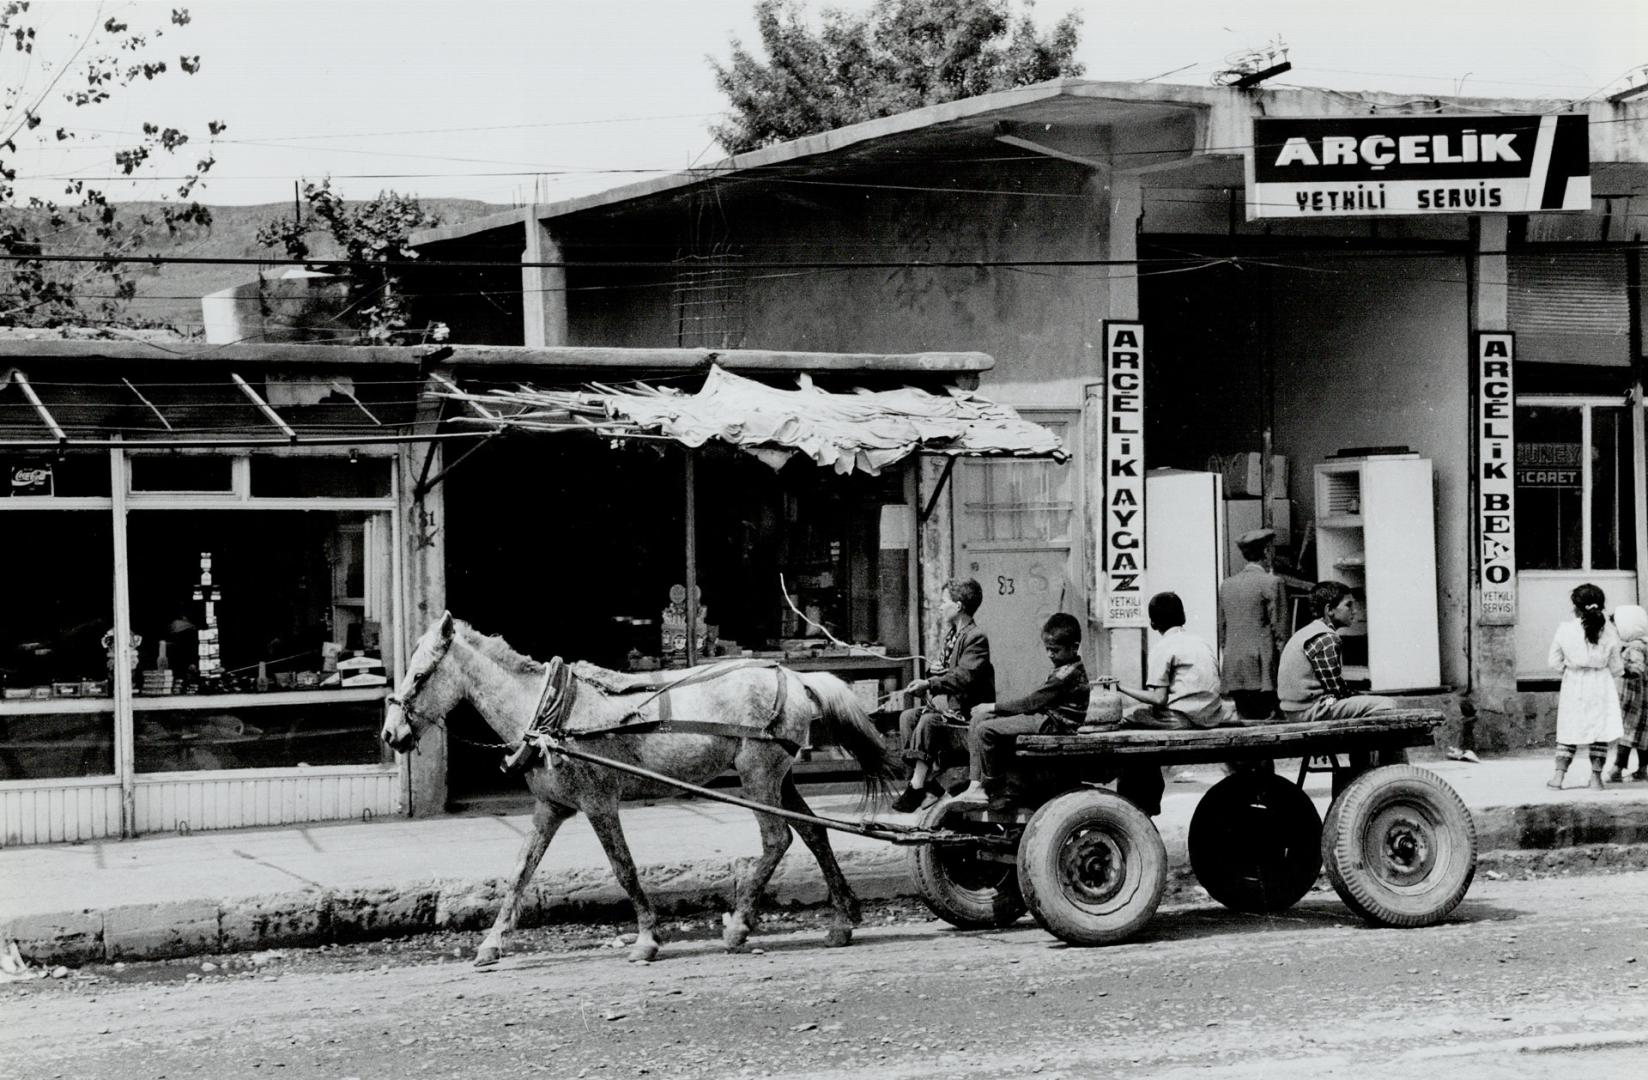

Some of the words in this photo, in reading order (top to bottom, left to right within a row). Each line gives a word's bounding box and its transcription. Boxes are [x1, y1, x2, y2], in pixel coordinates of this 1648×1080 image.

[1274, 128, 1522, 171] ARÇELİK
[1297, 182, 1386, 212] YETKİLİ
[1417, 181, 1502, 209] SERVİS
[1111, 488, 1140, 592] AYGAZ
[1483, 493, 1511, 584] BEKO
